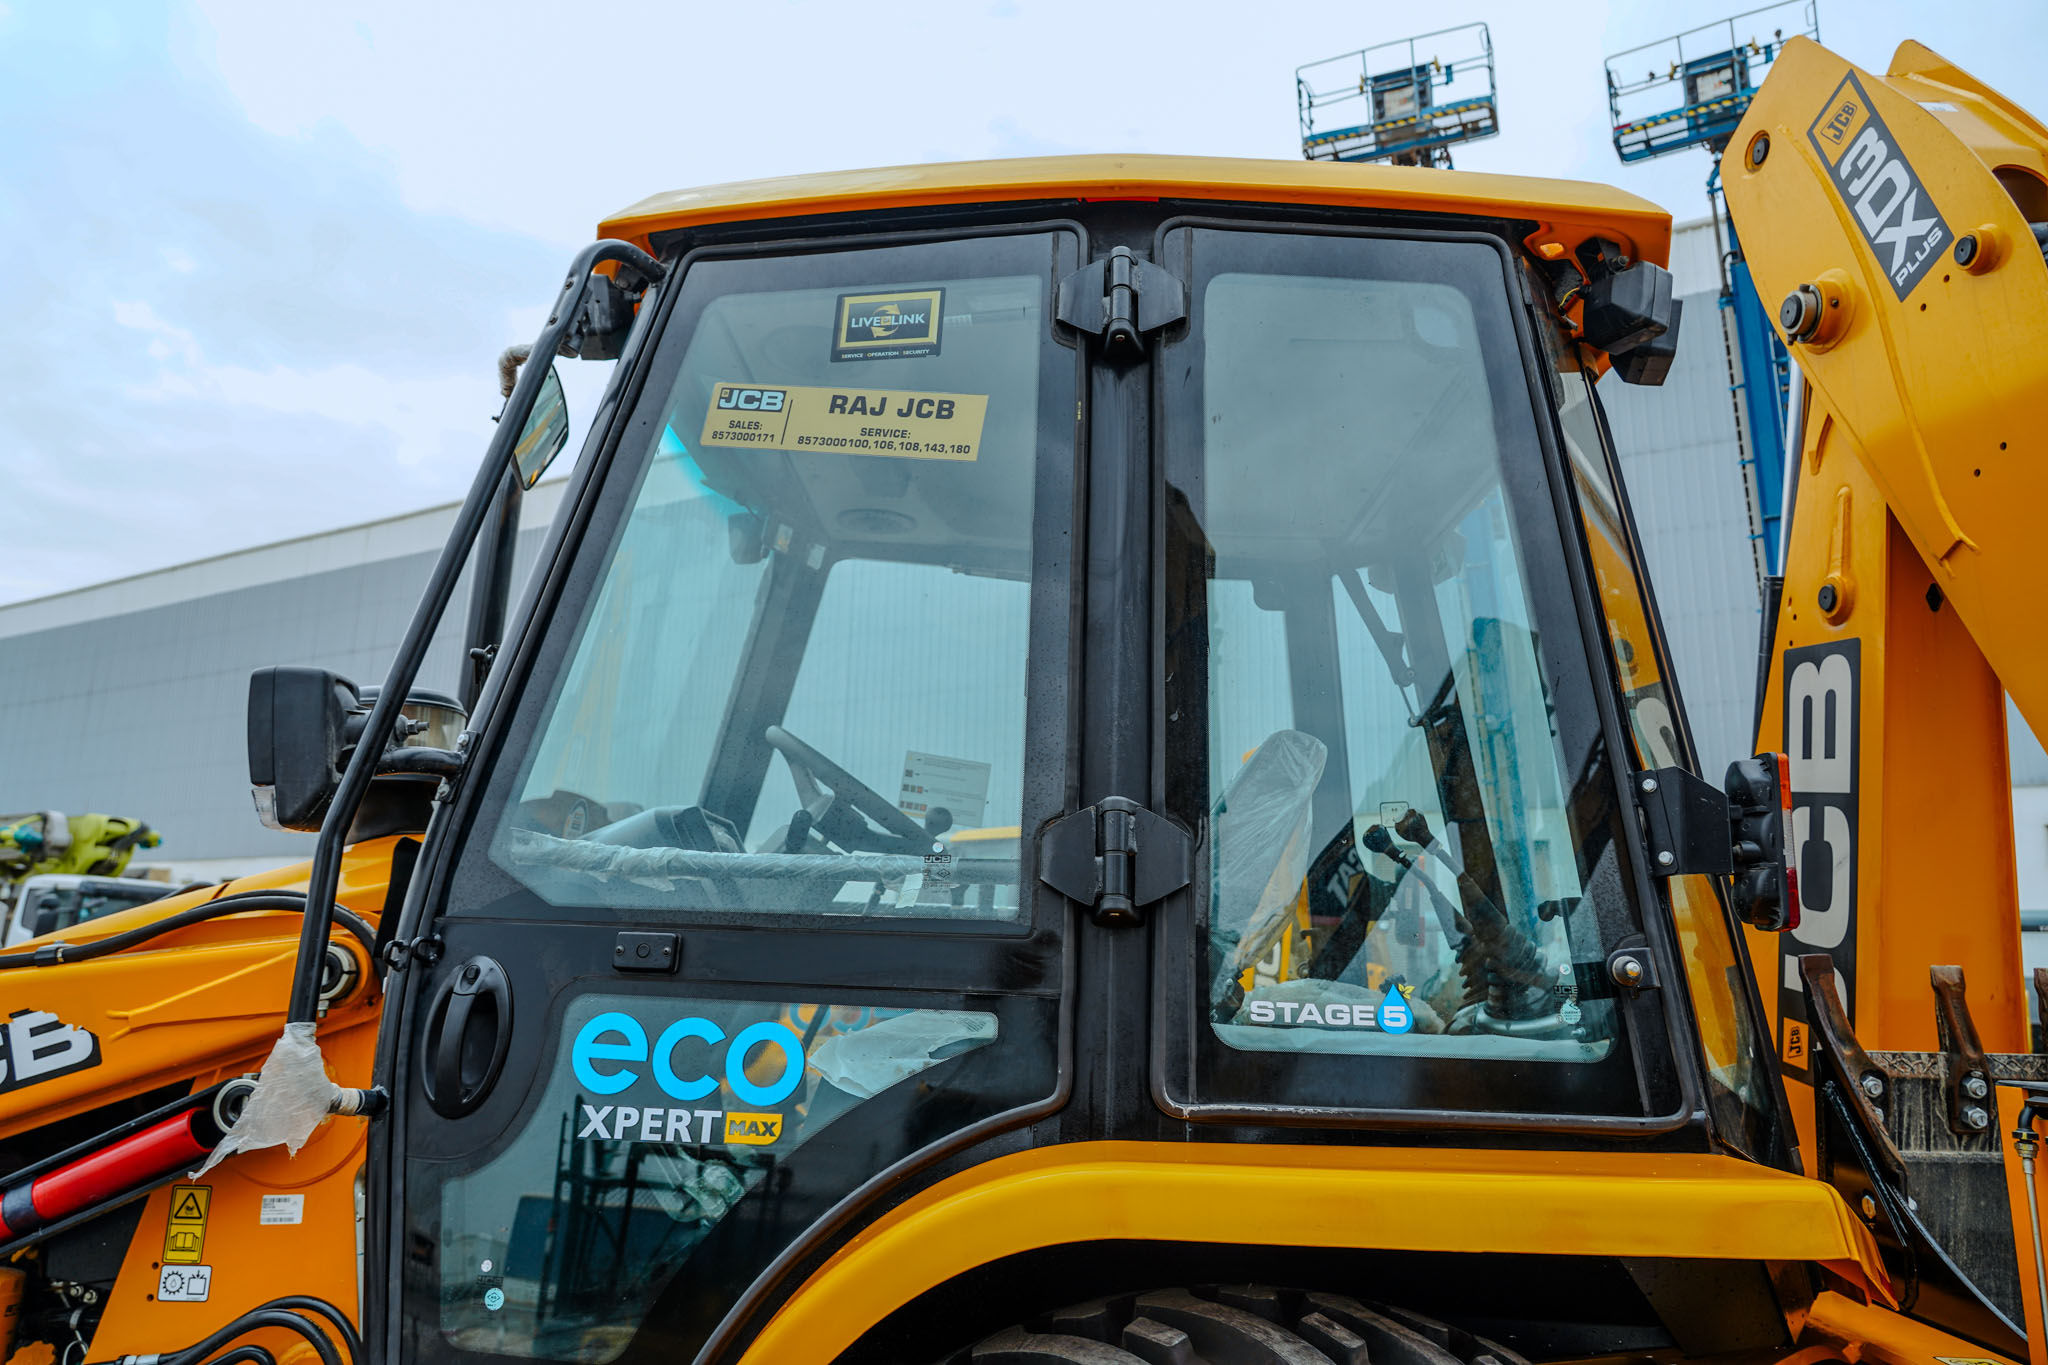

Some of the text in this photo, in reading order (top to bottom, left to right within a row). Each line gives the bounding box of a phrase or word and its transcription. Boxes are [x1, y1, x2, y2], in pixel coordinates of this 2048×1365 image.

[1824, 104, 1855, 141] JCB
[1895, 226, 1943, 287] PLUS
[851, 313, 925, 328] LIVE LINK
[719, 389, 956, 420] JCB RAJ JCB
[712, 430, 971, 455] 8573000171 8573000100,106,108,143,180
[729, 420, 911, 439] SALES: SERVICE:
[1250, 1000, 1408, 1028] STAGE 5
[1791, 1028, 1801, 1054] JCB
[571, 1012, 805, 1106] eco
[577, 1105, 779, 1144] XPERT MAX
